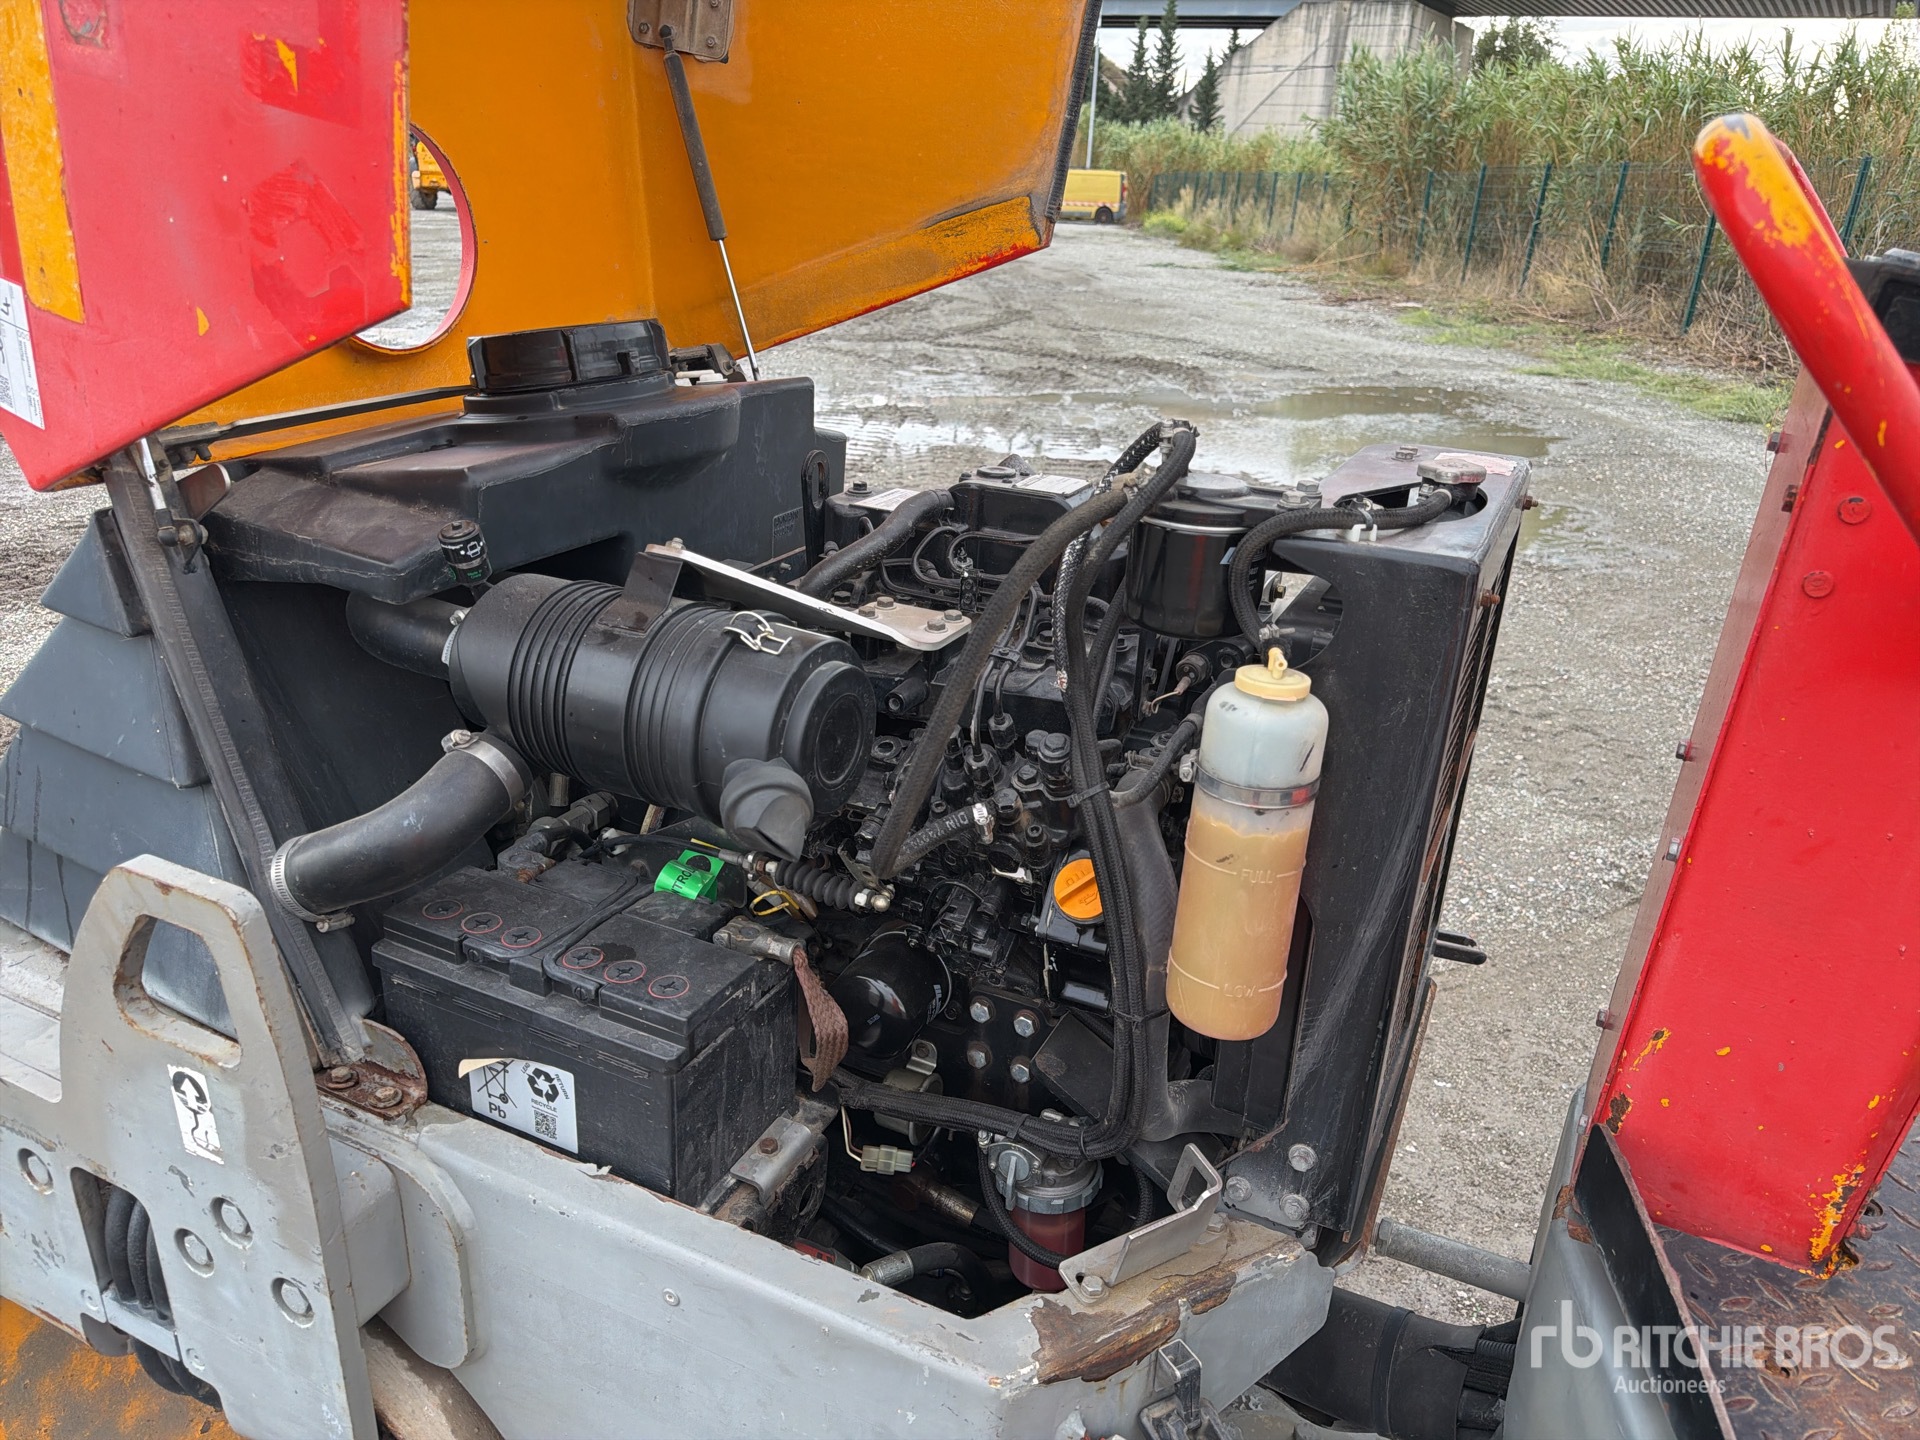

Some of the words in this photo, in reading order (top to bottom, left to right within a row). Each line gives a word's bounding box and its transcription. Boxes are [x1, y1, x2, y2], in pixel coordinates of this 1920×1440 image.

[945, 811, 969, 830] DIN
[1240, 868, 1275, 884] FULL
[1224, 983, 1257, 998] LOW
[554, 1073, 570, 1100] RETURN
[488, 1101, 507, 1119] Pb
[530, 1098, 558, 1113] RECYCLE
